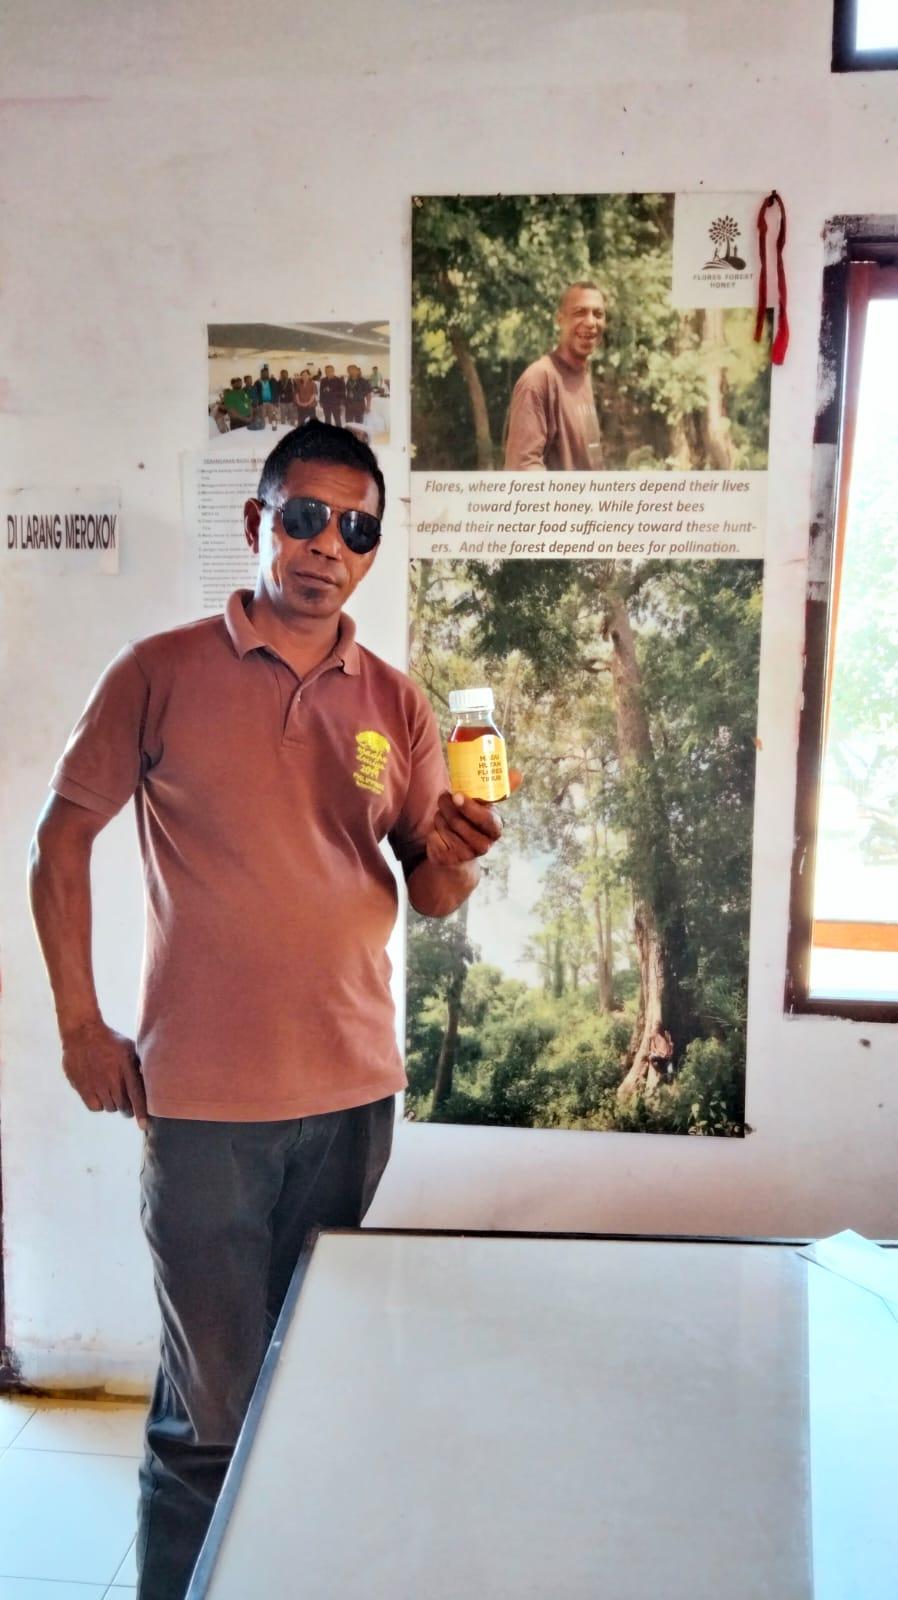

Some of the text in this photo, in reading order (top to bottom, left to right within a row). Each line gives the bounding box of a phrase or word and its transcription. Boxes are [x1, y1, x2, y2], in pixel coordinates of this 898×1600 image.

[425, 480, 751, 495] Flores, where forest honey hunters depend their lives
[467, 500, 705, 515] toward forest honey. While forest bees
[7, 514, 117, 549] DI LARANG MEROKOK
[417, 520, 757, 535] depend their nectar food sufficiency toward these hunt-
[431, 540, 740, 555] ers. And the forest depend on bees for pollination.
